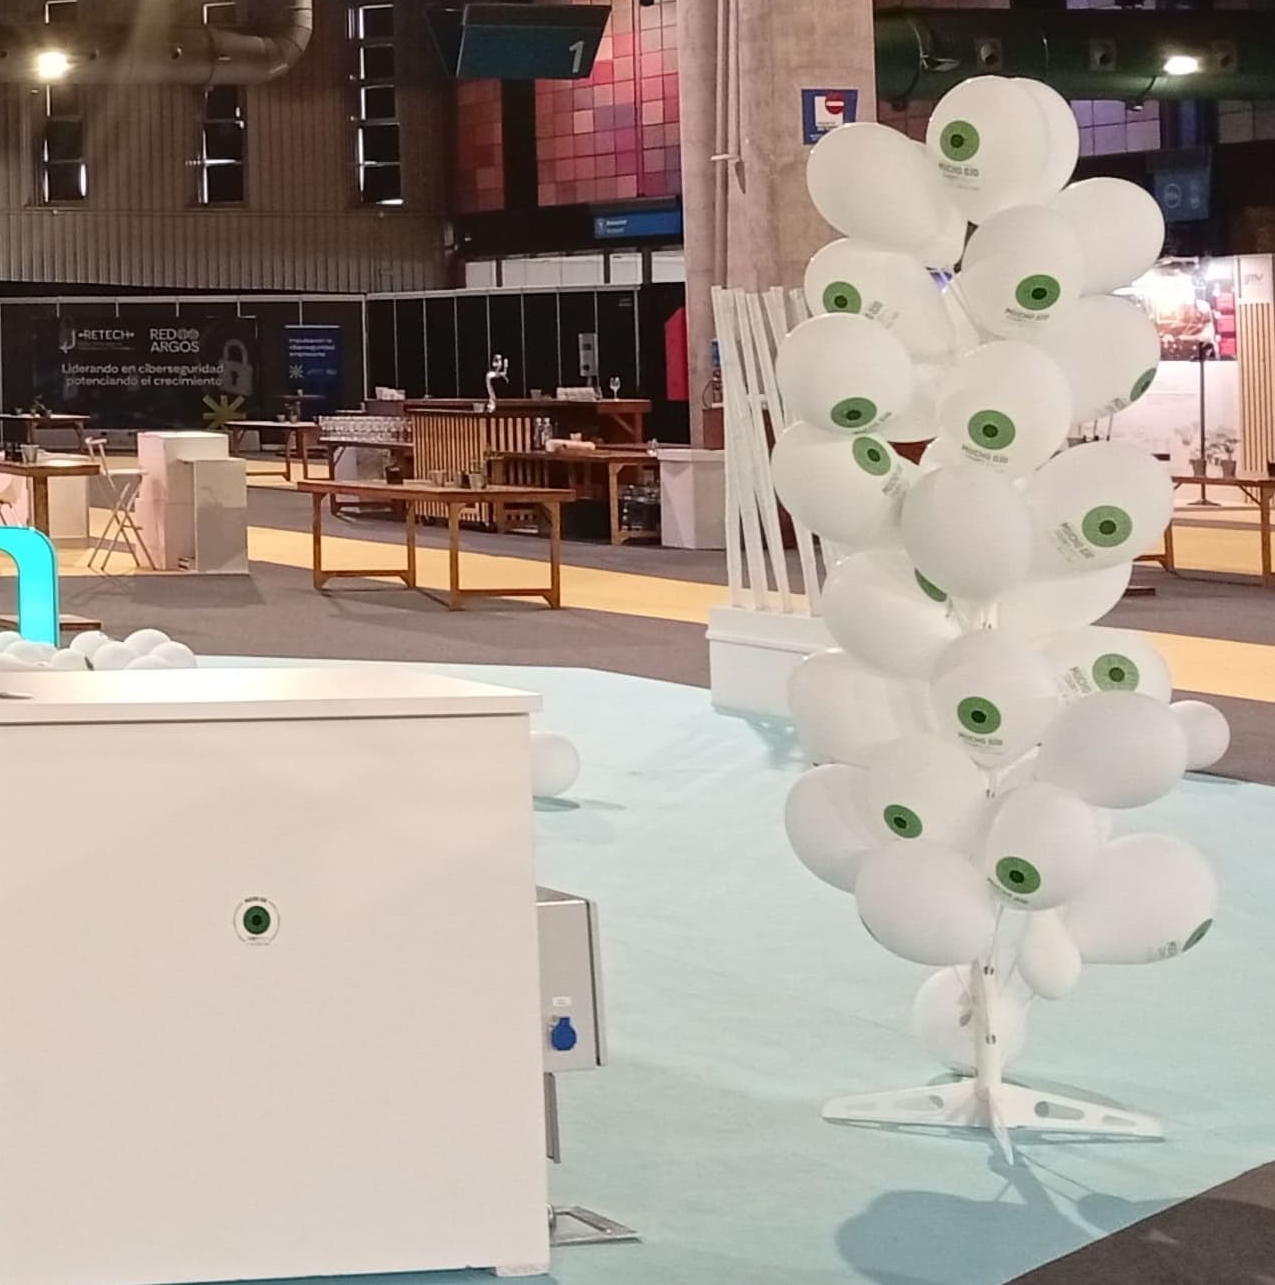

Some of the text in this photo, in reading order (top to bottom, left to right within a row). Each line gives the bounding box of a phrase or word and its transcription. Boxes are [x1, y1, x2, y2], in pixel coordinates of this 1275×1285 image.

[568, 40, 585, 74] 1
[83, 329, 130, 340] RETECH
[149, 328, 177, 341] RED
[150, 341, 200, 353] ARGOS
[61, 363, 224, 376] Liderando en ciberseguridad
[66, 375, 222, 387] potenciando el crecimiento
